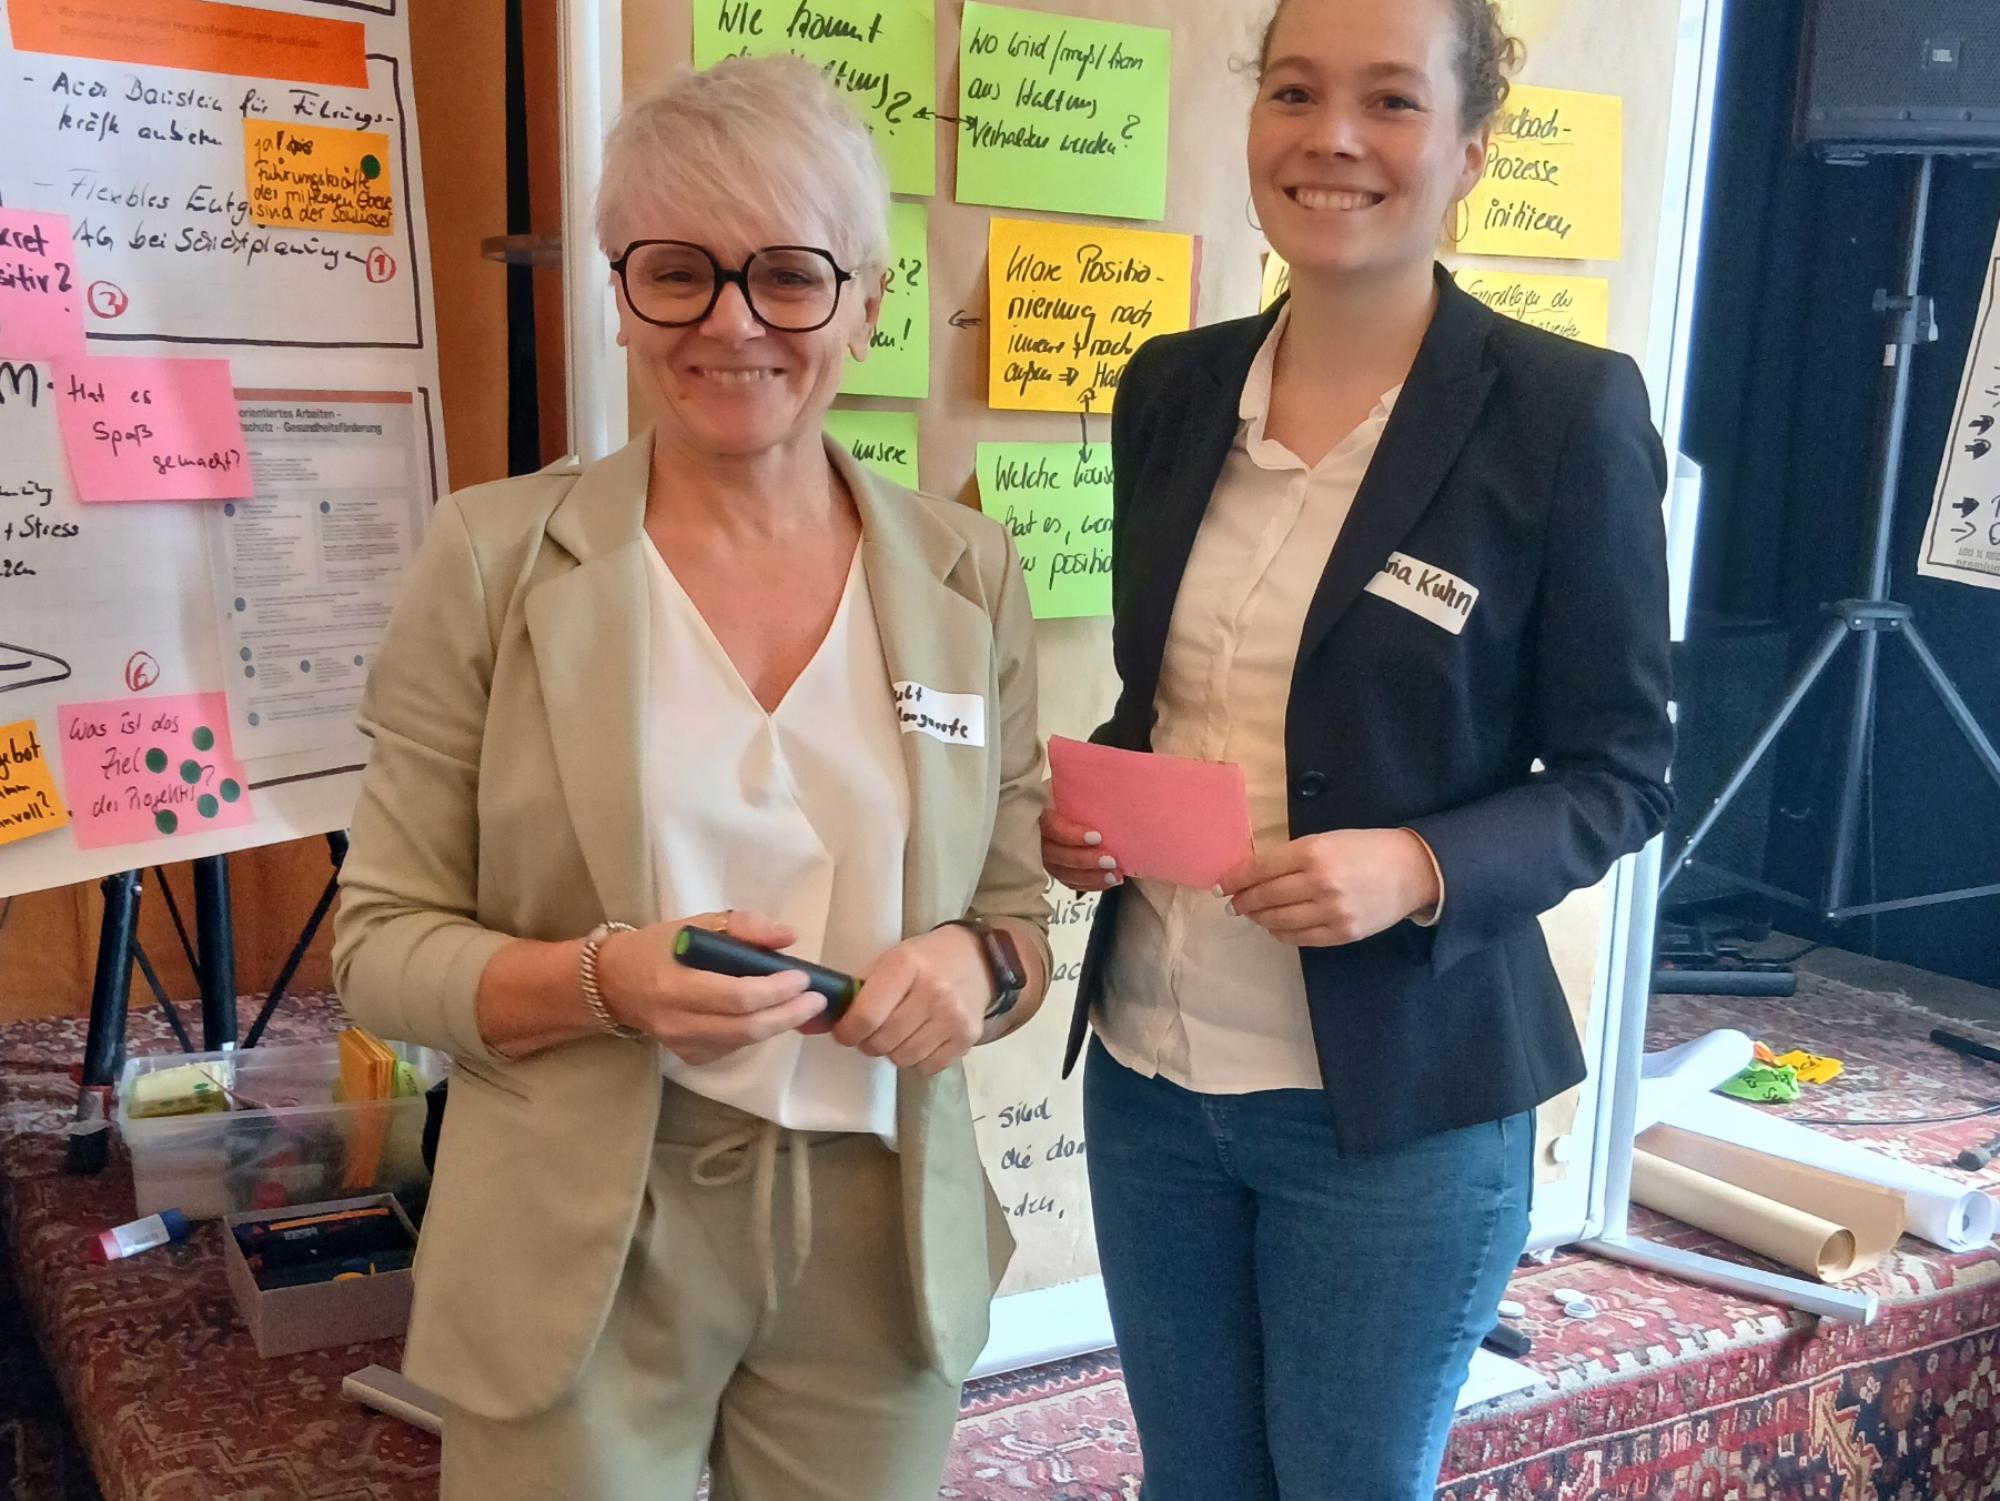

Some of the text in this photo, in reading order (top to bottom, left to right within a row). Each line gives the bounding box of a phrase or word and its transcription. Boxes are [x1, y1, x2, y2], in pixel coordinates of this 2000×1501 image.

[1483, 142, 1560, 186] Prozesse
[1092, 360, 1128, 389] Hal
[130, 389, 152, 405] es
[238, 407, 336, 419] orientiertes Arbeiten
[240, 422, 274, 433] schutz
[92, 421, 153, 457] Spaß
[995, 455, 1060, 491] Welche
[19, 514, 79, 539] Stress
[1048, 547, 1113, 591] positio
[1415, 568, 1473, 616] Kuhn
[69, 717, 108, 742] Was
